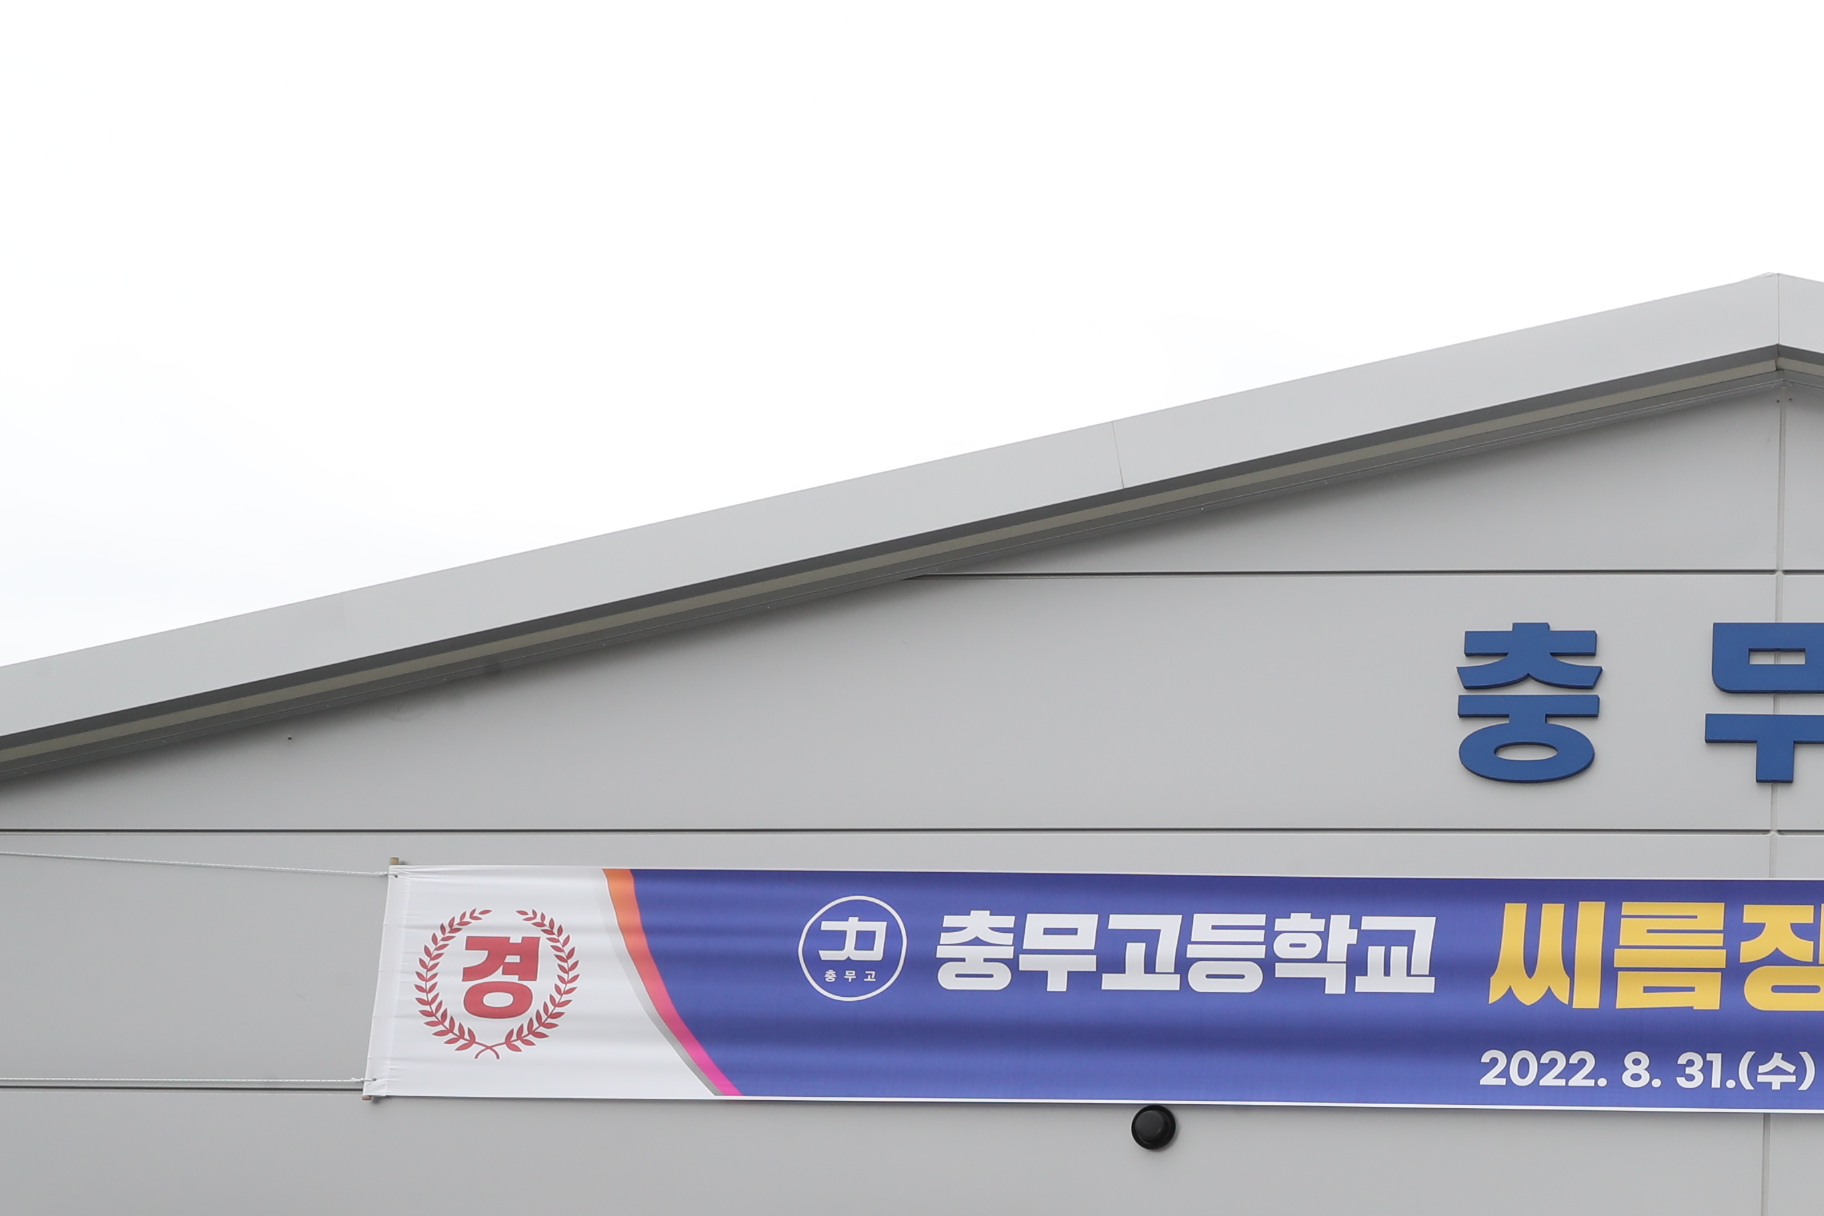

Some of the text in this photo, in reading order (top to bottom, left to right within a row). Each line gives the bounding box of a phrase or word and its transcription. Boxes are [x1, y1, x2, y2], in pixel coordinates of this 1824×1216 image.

[460, 934, 539, 1020] 경
[824, 969, 877, 983] 충무고
[934, 909, 1436, 996] 충무고등학교
[1479, 1050, 1608, 1088] 2022.
[1622, 1051, 1662, 1089] 8.
[1676, 1050, 1816, 1093] 31.(수)
